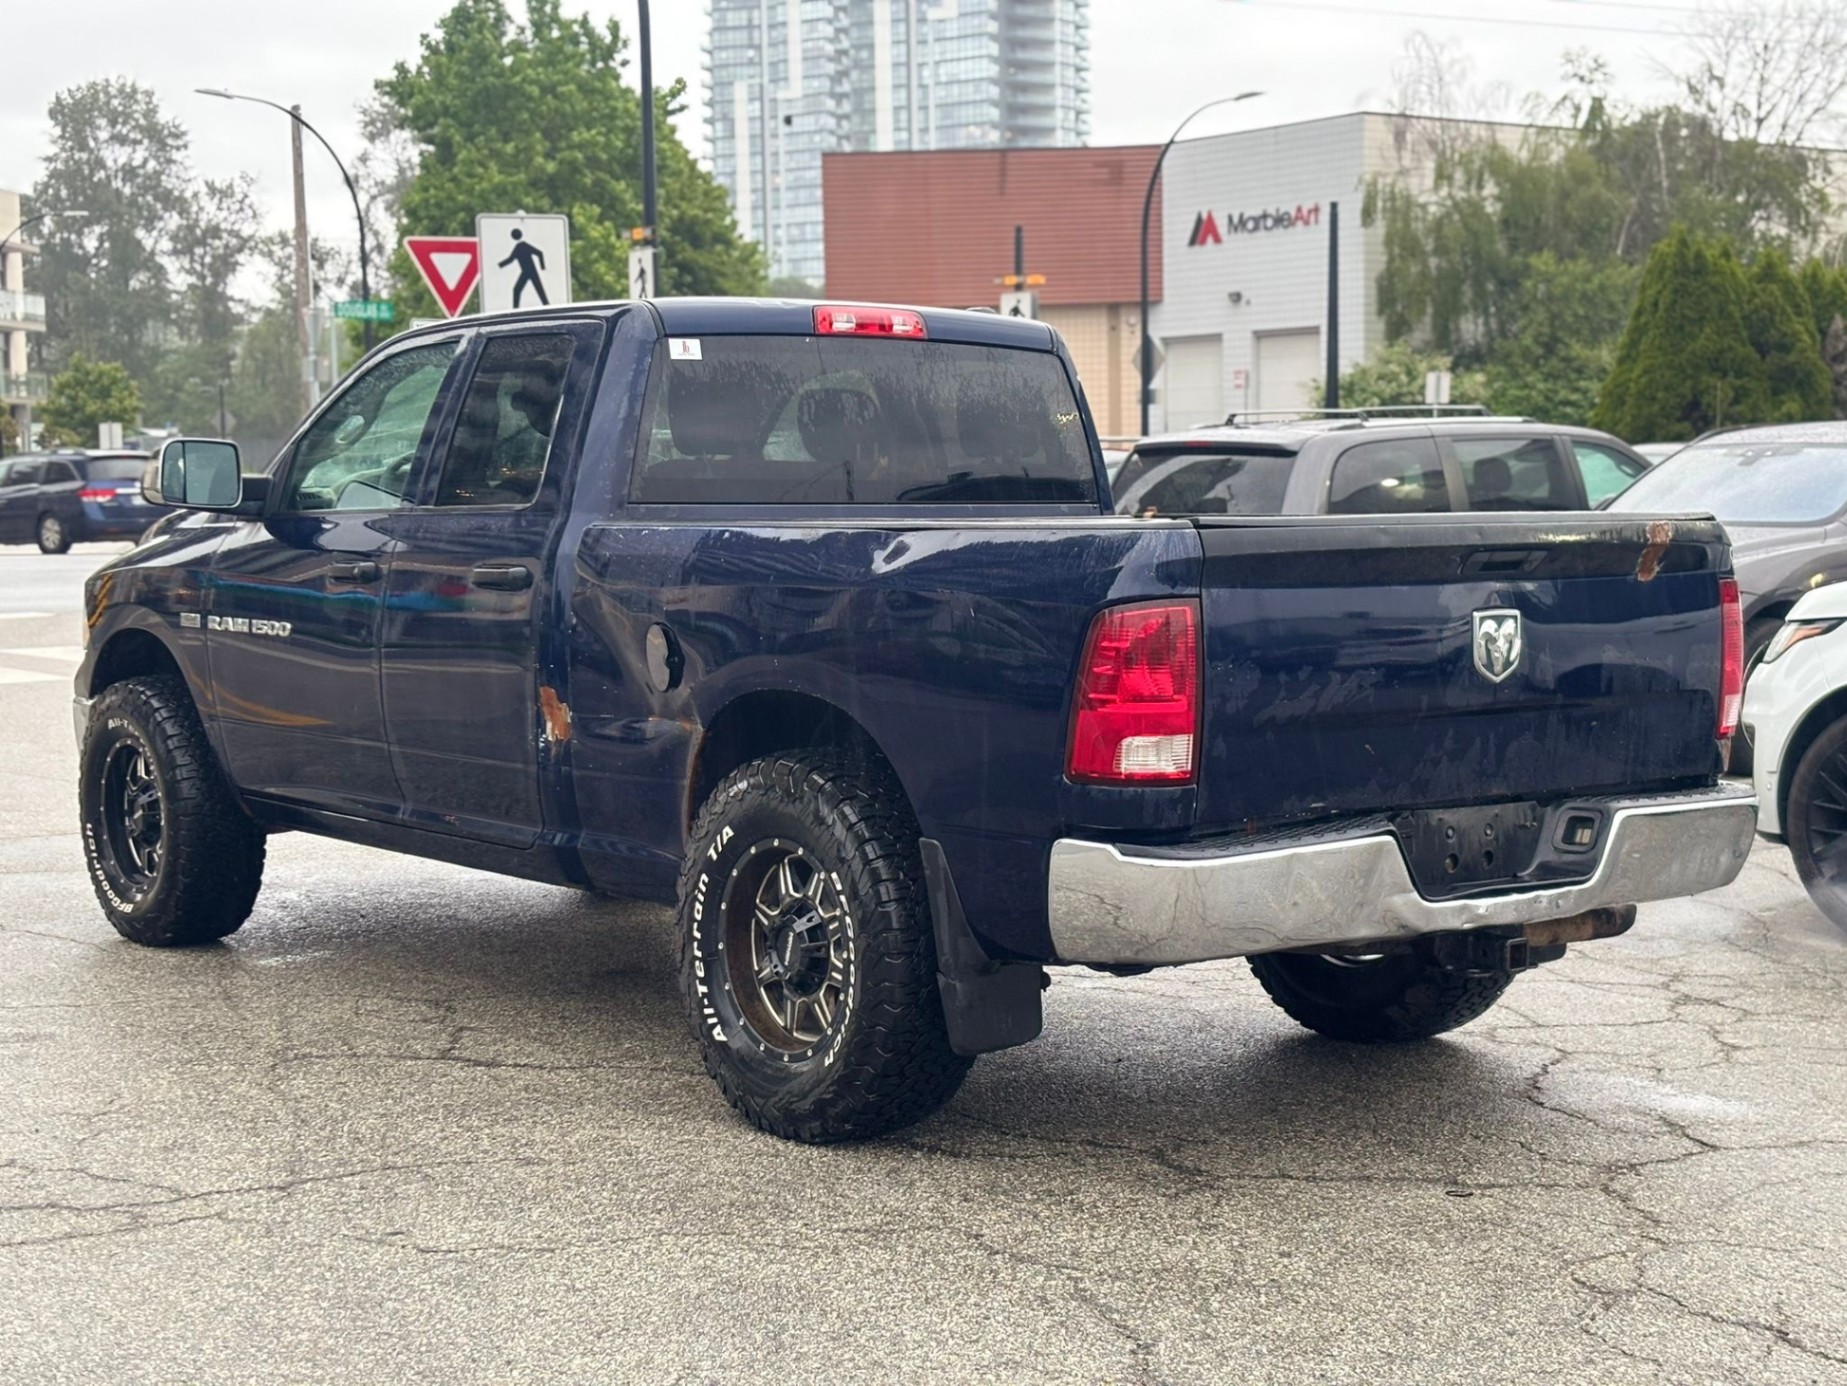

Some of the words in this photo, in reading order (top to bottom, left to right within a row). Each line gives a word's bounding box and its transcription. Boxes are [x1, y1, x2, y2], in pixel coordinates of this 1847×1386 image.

[1227, 203, 1320, 235] MarbleArt
[207, 615, 250, 633] RAM
[251, 619, 292, 637] 1500
[707, 825, 735, 861] T/A
[693, 873, 728, 1042] All-Terrain
[825, 871, 856, 1067] BFGoodrich
